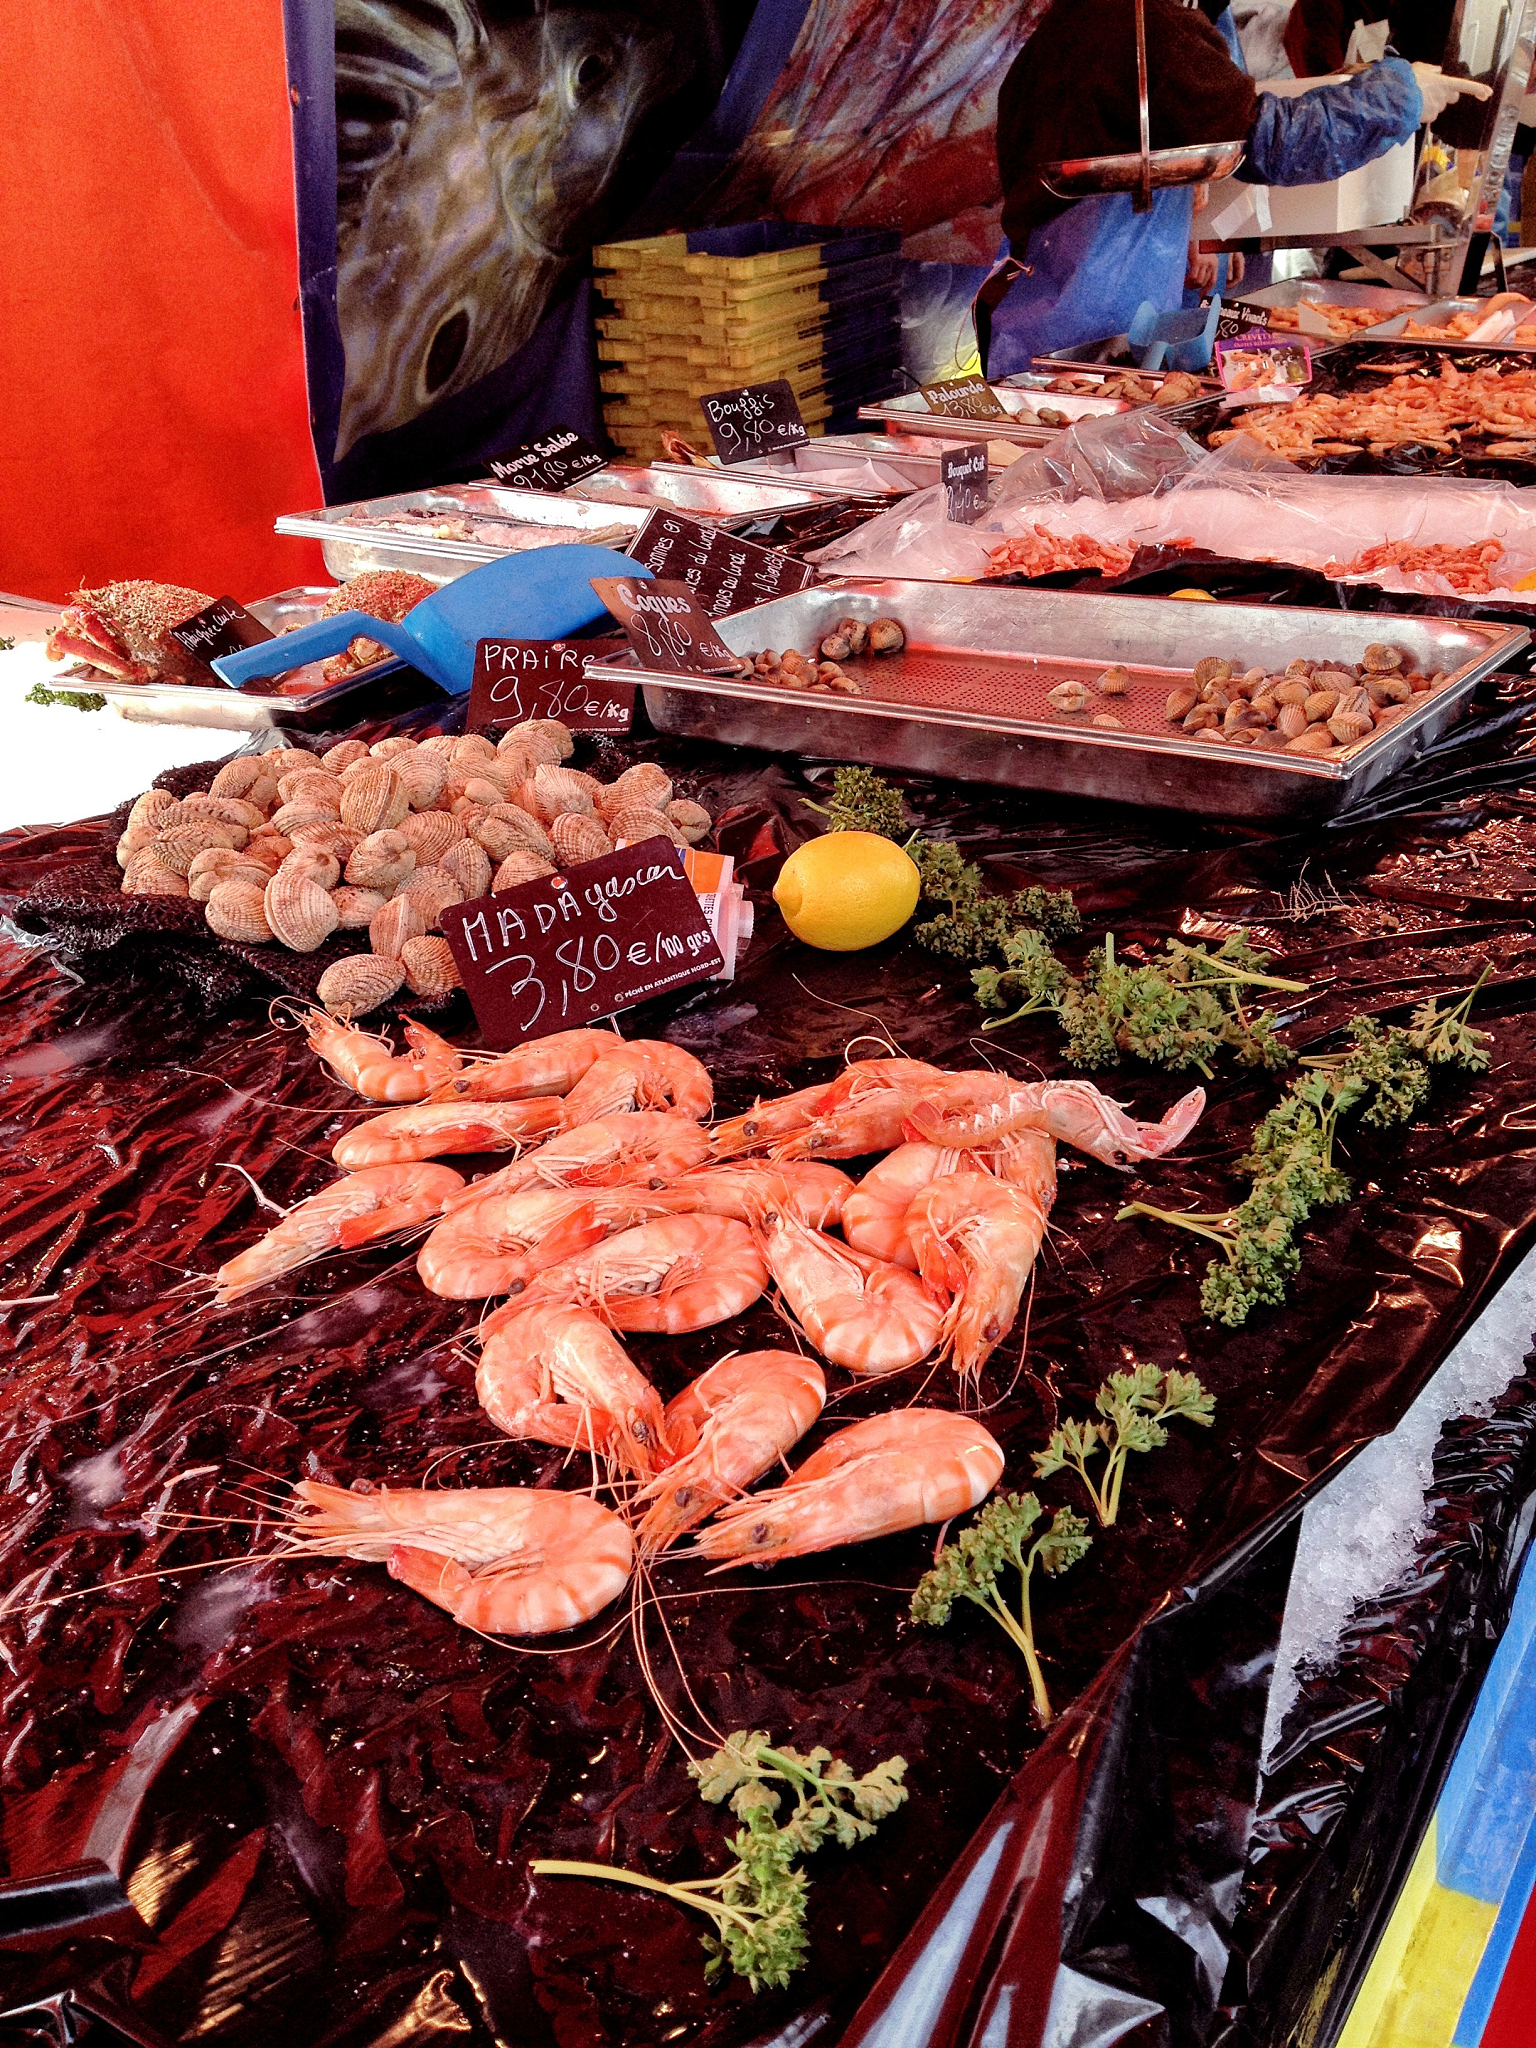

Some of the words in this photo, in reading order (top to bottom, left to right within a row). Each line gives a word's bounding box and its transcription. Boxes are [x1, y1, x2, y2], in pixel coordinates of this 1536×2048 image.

[707, 394, 775, 422] Bouffis
[926, 380, 986, 404] Palourde
[941, 396, 982, 417] 13,80
[719, 419, 775, 455] 9,80
[777, 422, 806, 437] €/Kg
[490, 453, 540, 479] Morue
[533, 432, 579, 457] Salée
[947, 458, 973, 480] Bouquet
[973, 454, 985, 473] Cuit
[616, 583, 692, 623] Coques
[631, 614, 693, 667] 8,80
[490, 675, 589, 723] 9,80
[583, 699, 629, 722] €/Kg
[485, 934, 620, 1031] 3,80
[686, 929, 711, 957] grs
[644, 983, 654, 991] EN
[654, 968, 692, 988] ATLANTIQUE
[691, 956, 721, 973] NORD-EST
